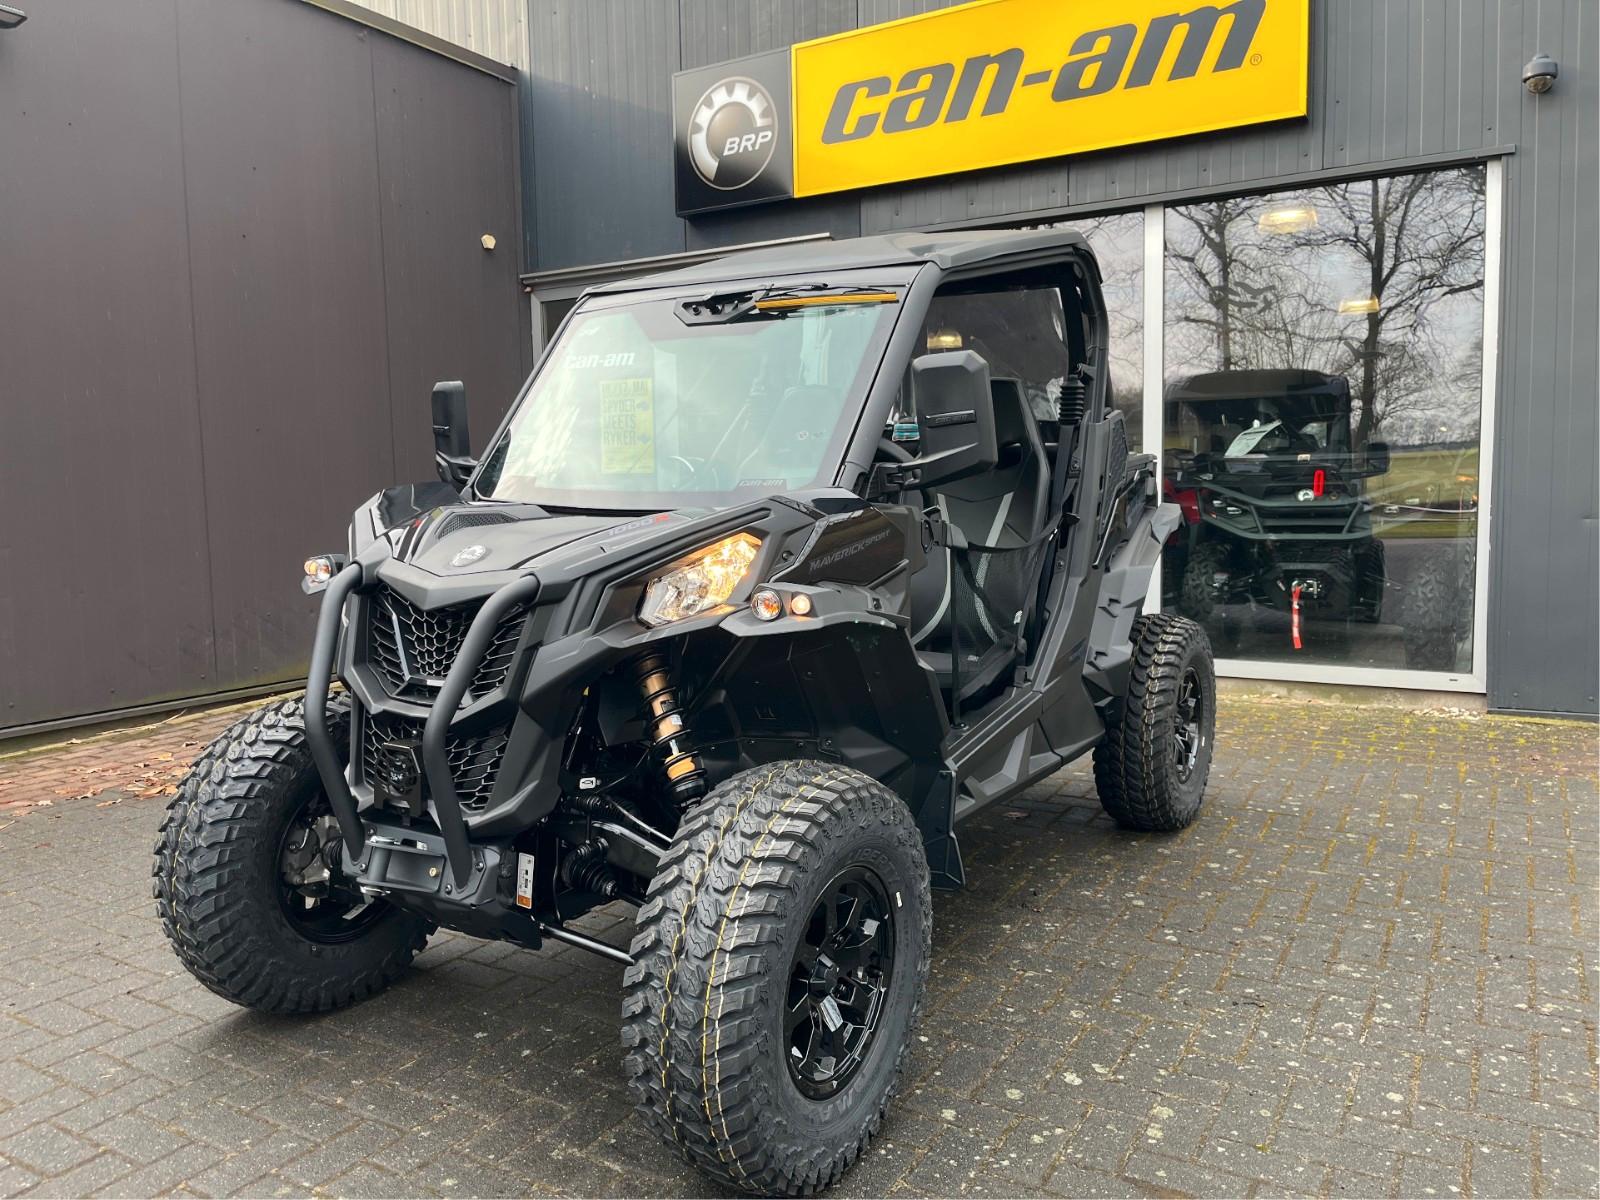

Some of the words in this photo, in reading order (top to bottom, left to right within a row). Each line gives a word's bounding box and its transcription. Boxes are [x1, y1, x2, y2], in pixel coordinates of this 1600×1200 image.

[820, 0, 1267, 146] can-am
[723, 130, 773, 156] BRP
[564, 352, 636, 370] can-am
[808, 541, 865, 573] MAVERICK
[863, 528, 891, 547] SPORT
